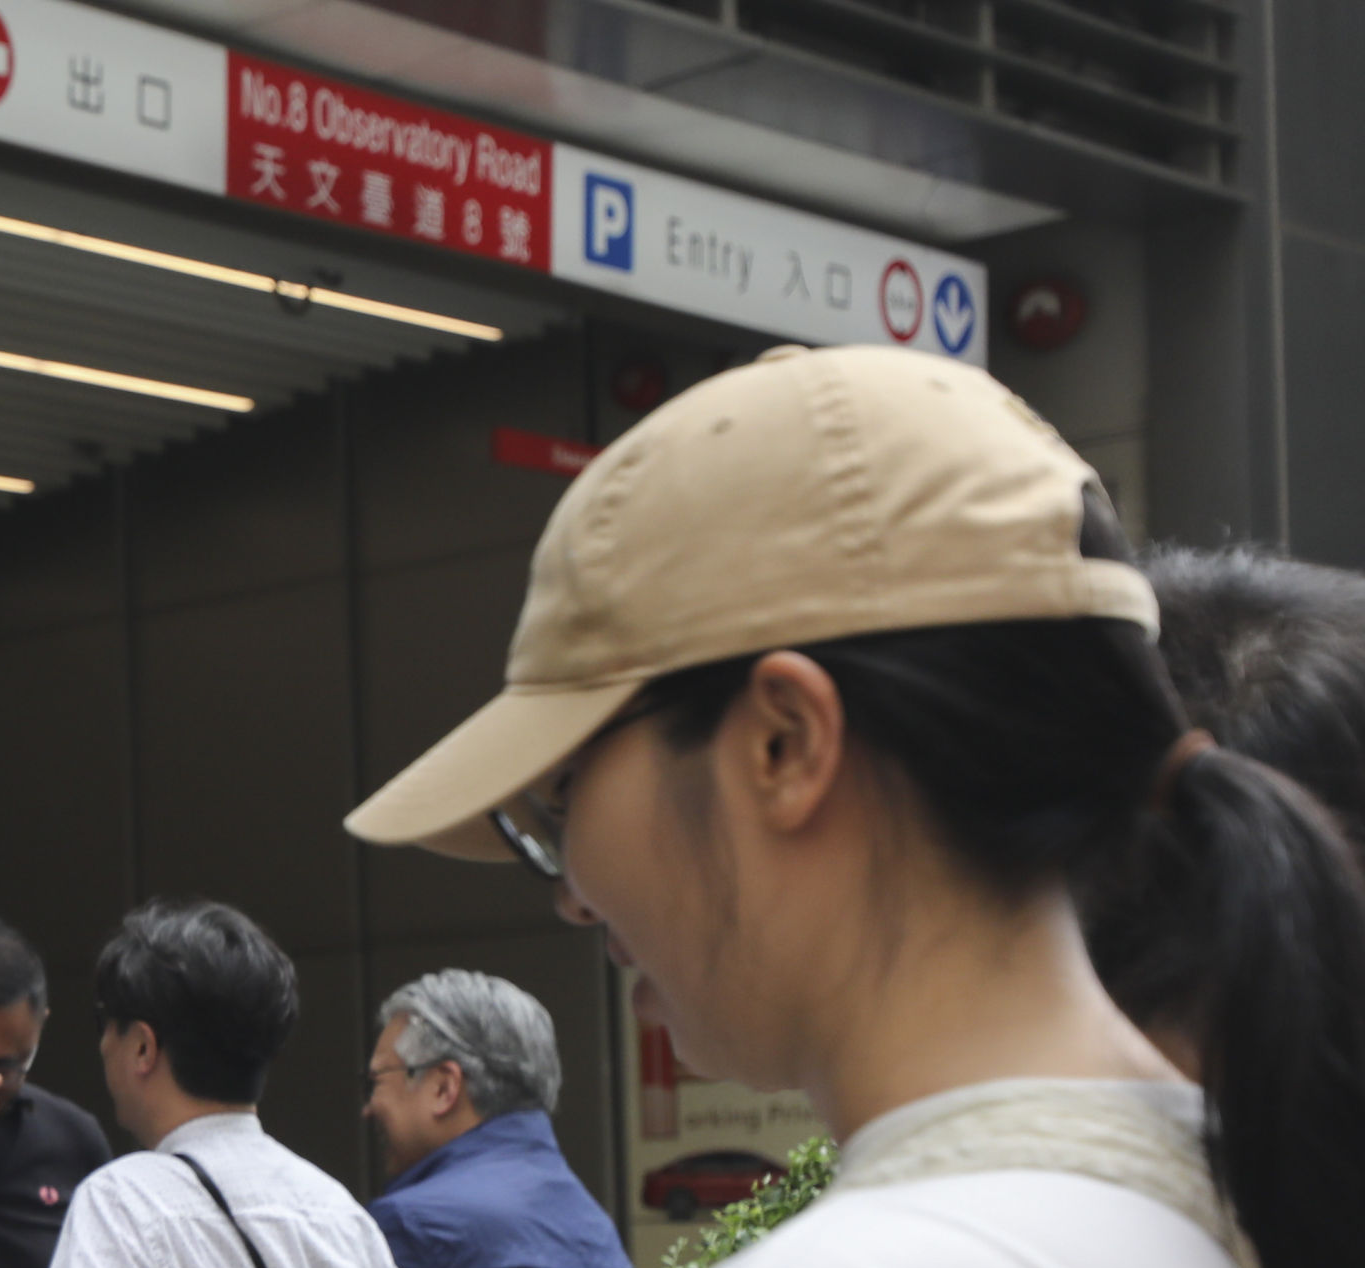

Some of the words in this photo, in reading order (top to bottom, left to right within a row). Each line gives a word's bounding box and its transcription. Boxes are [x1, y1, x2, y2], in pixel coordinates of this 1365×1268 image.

[68, 56, 172, 131] 出口
[240, 67, 309, 132] No.8
[313, 88, 473, 186] Observatory
[475, 133, 541, 195] Road
[667, 214, 755, 295] Entry
[781, 250, 853, 311] 入口
